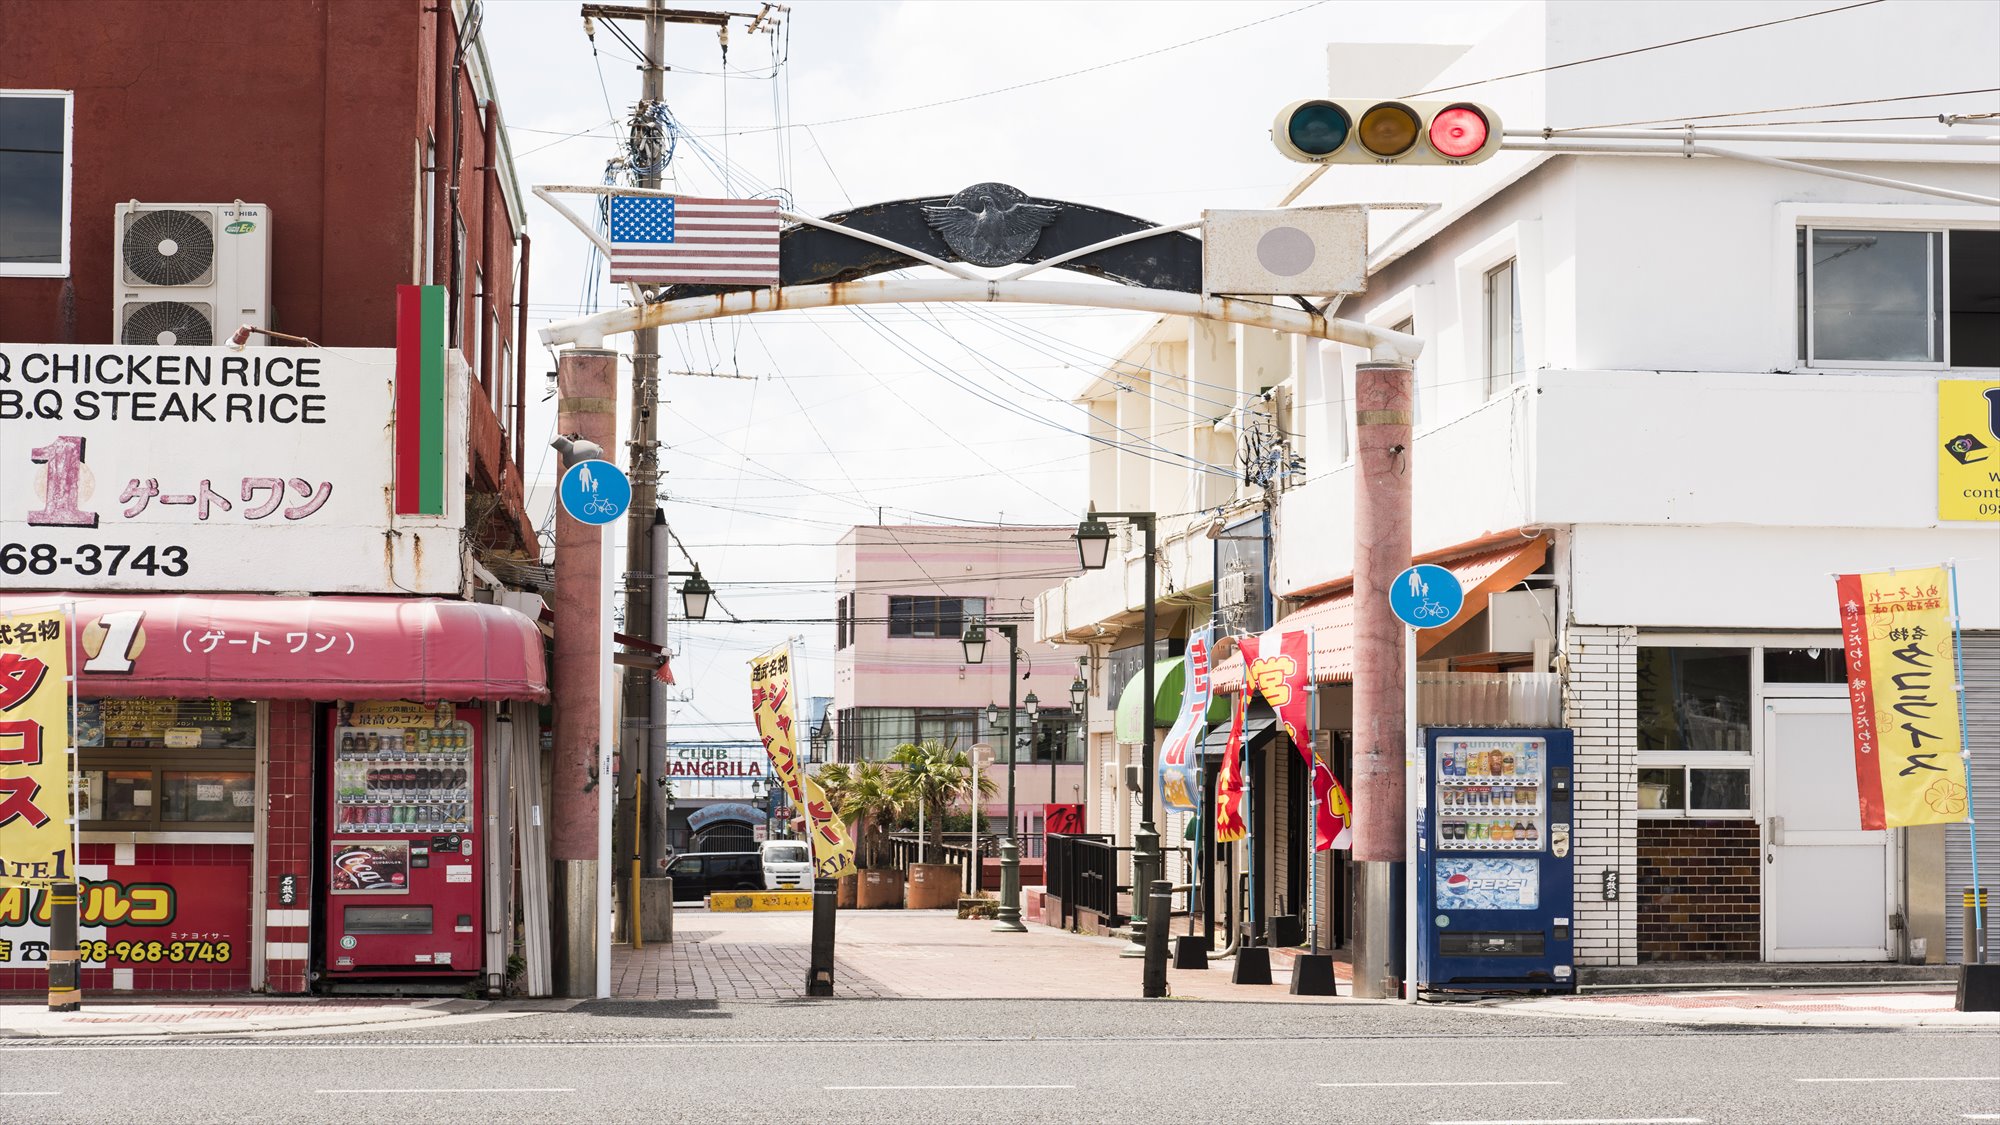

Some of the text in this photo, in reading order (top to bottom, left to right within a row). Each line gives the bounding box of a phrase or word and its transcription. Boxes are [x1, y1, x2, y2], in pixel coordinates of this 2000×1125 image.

[21, 352, 211, 386] CHICKEN
[221, 354, 321, 388] RICE
[73, 390, 216, 423] STEAK
[227, 392, 326, 424] RICE
[27, 435, 100, 529] 1
[119, 477, 333, 521] ゲート ワン
[1979, 503, 2000, 515] 09
[0, 543, 189, 577] 68-3743
[83, 611, 147, 675] 1
[678, 748, 728, 760] CLUB
[1469, 741, 1516, 749] UNTORY
[79, 940, 232, 963] 98-968-3743
